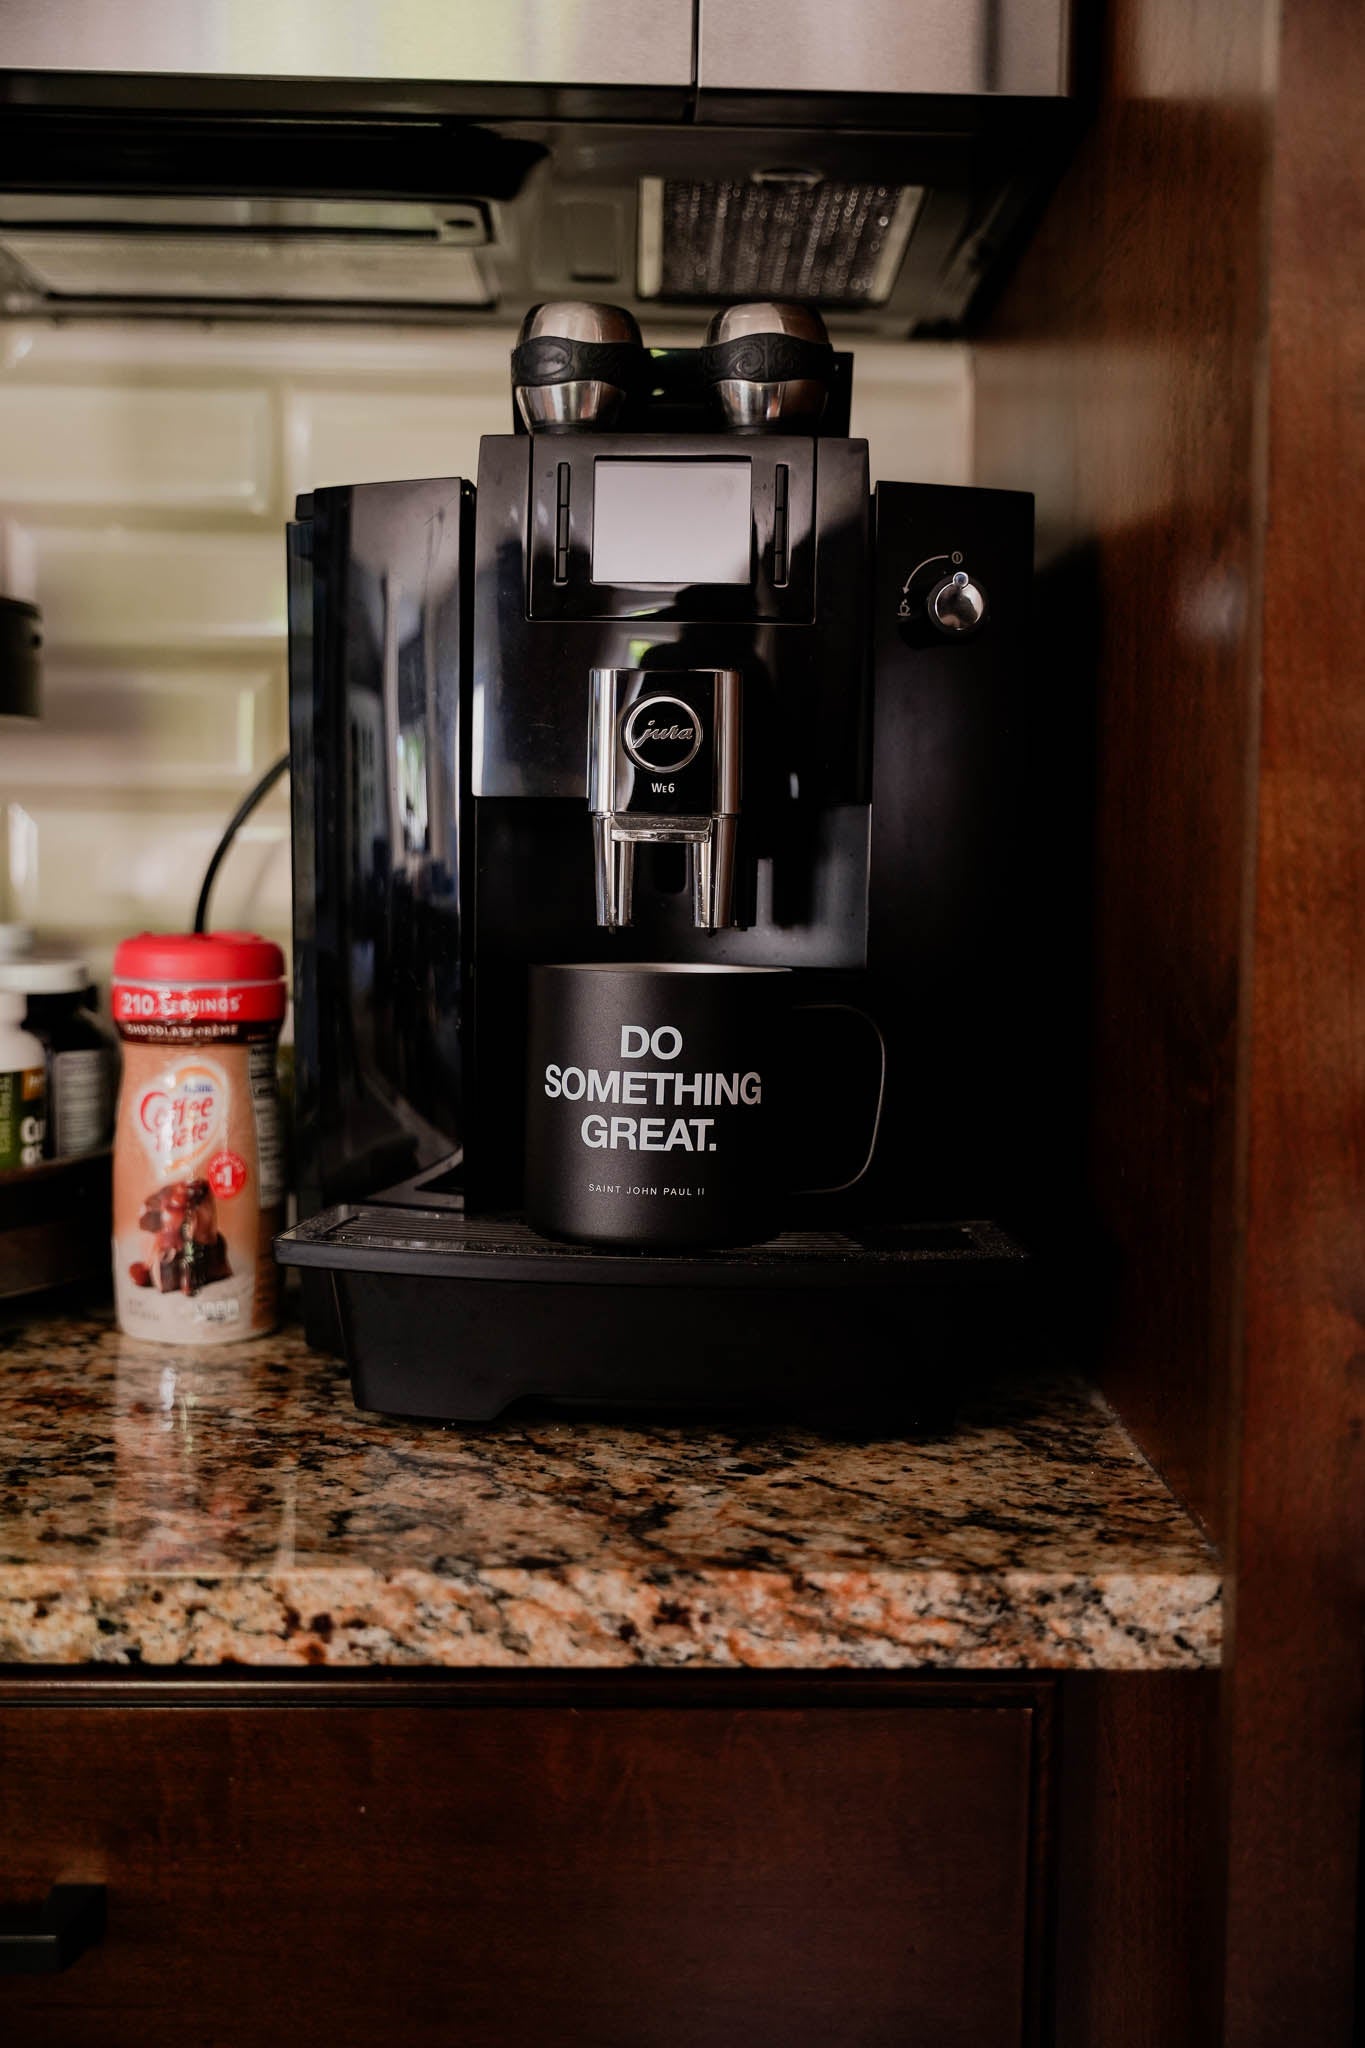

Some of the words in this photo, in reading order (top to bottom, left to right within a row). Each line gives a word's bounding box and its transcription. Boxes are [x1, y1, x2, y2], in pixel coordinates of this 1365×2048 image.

[632, 720, 693, 749] jura
[122, 991, 154, 1015] 210
[620, 1025, 683, 1060] DO
[544, 1063, 762, 1106] SOMETHING
[581, 1114, 717, 1151] GREAT.
[588, 1183, 621, 1194] SAINT
[626, 1186, 657, 1195] JOHN
[663, 1187, 692, 1196] PAUL
[697, 1187, 705, 1196] II
